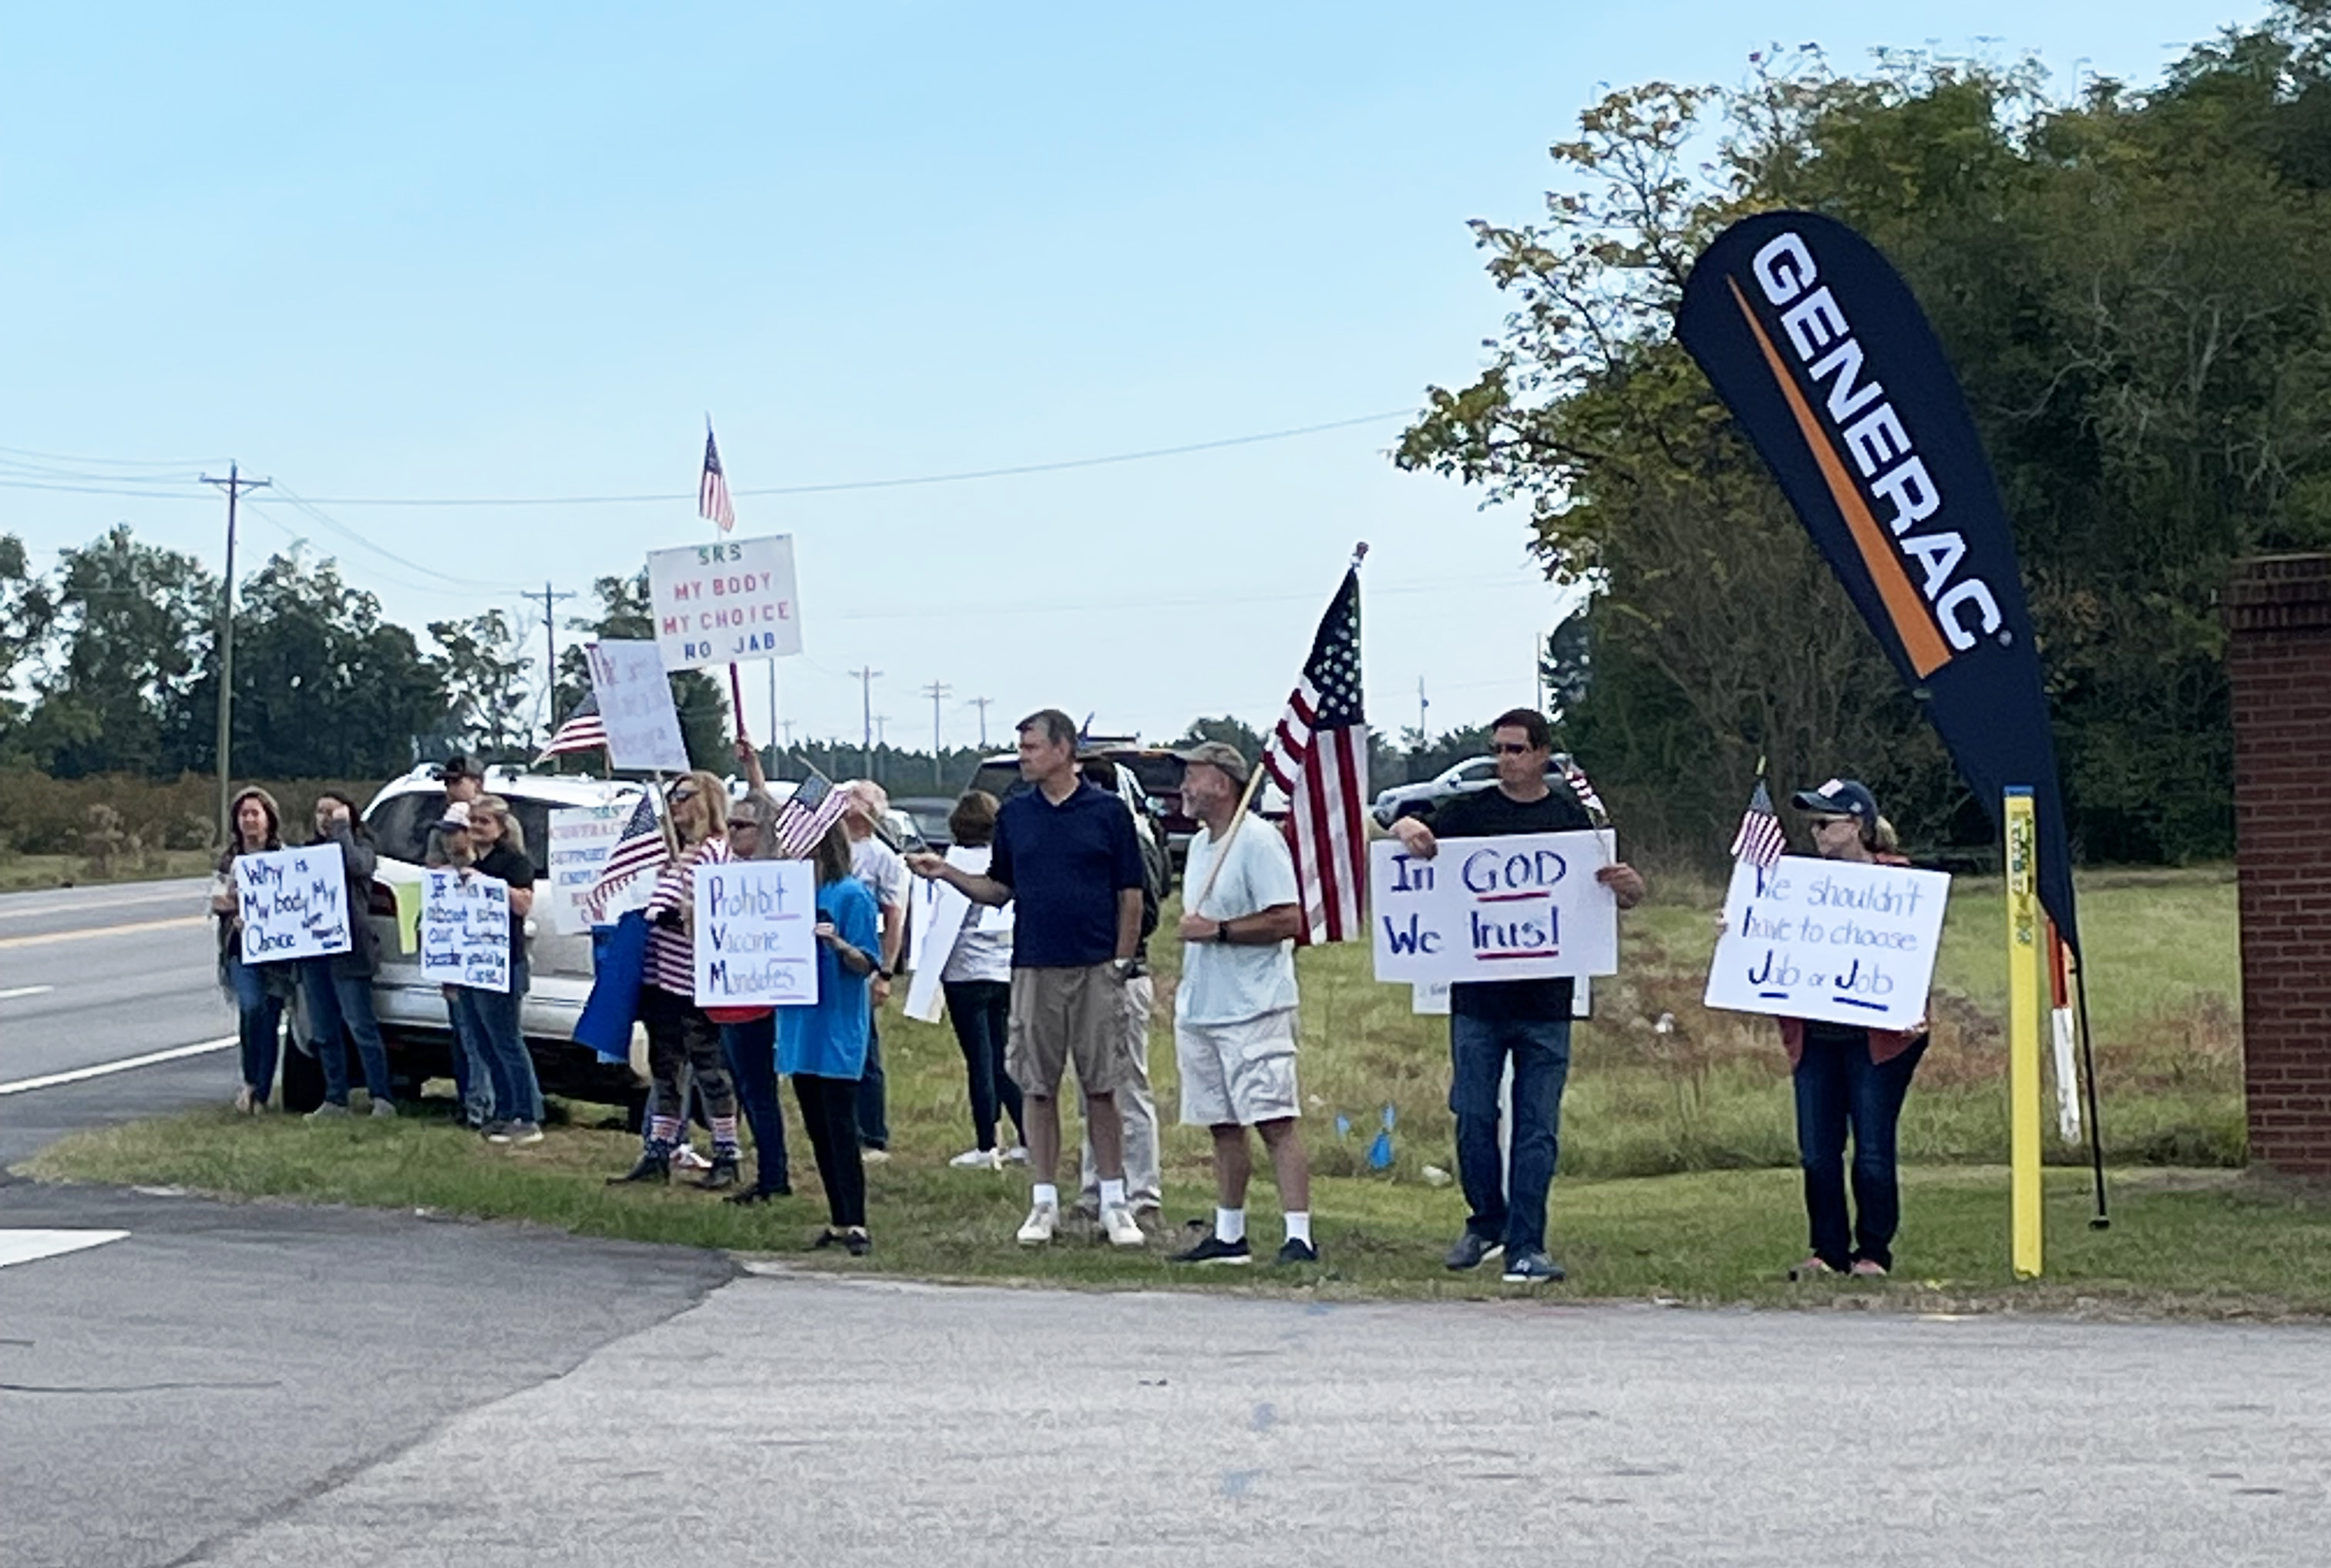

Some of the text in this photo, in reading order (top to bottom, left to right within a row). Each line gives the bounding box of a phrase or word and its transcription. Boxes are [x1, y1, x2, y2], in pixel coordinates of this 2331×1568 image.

[1752, 231, 2003, 651] GENERAC
[698, 543, 742, 565] SRS
[674, 572, 771, 601] MY BODY
[663, 601, 790, 635] MY CHOICE
[684, 632, 775, 661] NO JAB
[242, 859, 284, 892] Why
[1391, 848, 1566, 893] In GOD
[312, 877, 338, 913] My
[1755, 863, 1922, 917] We shouldn't
[247, 924, 295, 956] Choice
[709, 922, 781, 953] Vaccine
[1383, 913, 1445, 955] We
[1742, 905, 1919, 951] have to choose
[709, 960, 796, 995] Mandates
[1808, 973, 1826, 987] or
[1835, 958, 1893, 994] Job
